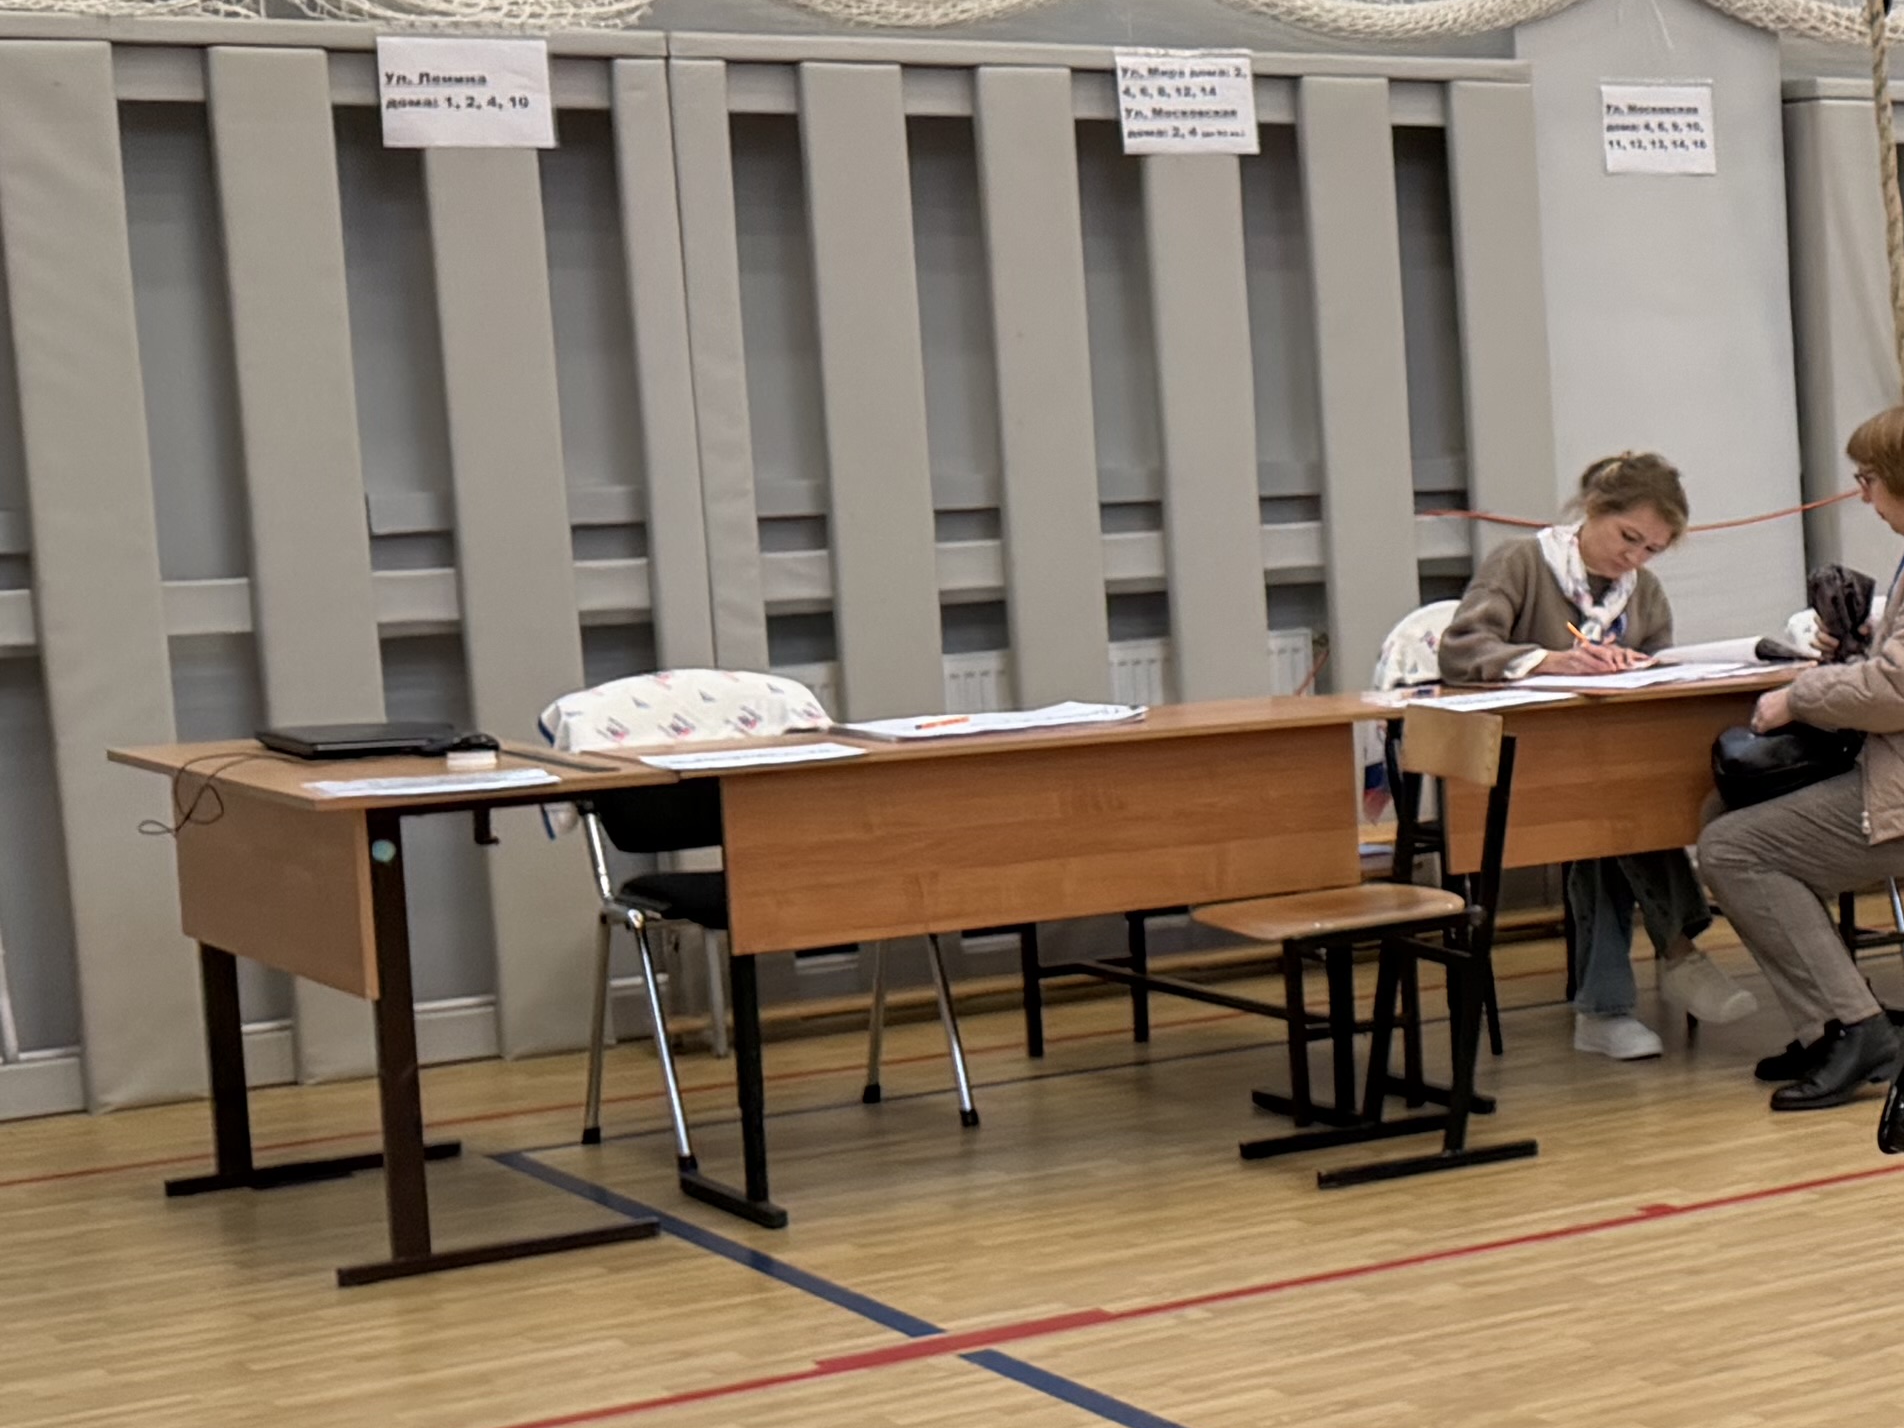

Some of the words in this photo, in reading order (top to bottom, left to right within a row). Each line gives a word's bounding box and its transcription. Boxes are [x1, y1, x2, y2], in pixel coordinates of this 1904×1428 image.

[445, 96, 461, 110] 1,
[465, 96, 482, 110] 2,
[487, 96, 504, 110] 4,
[509, 96, 530, 109] 10
